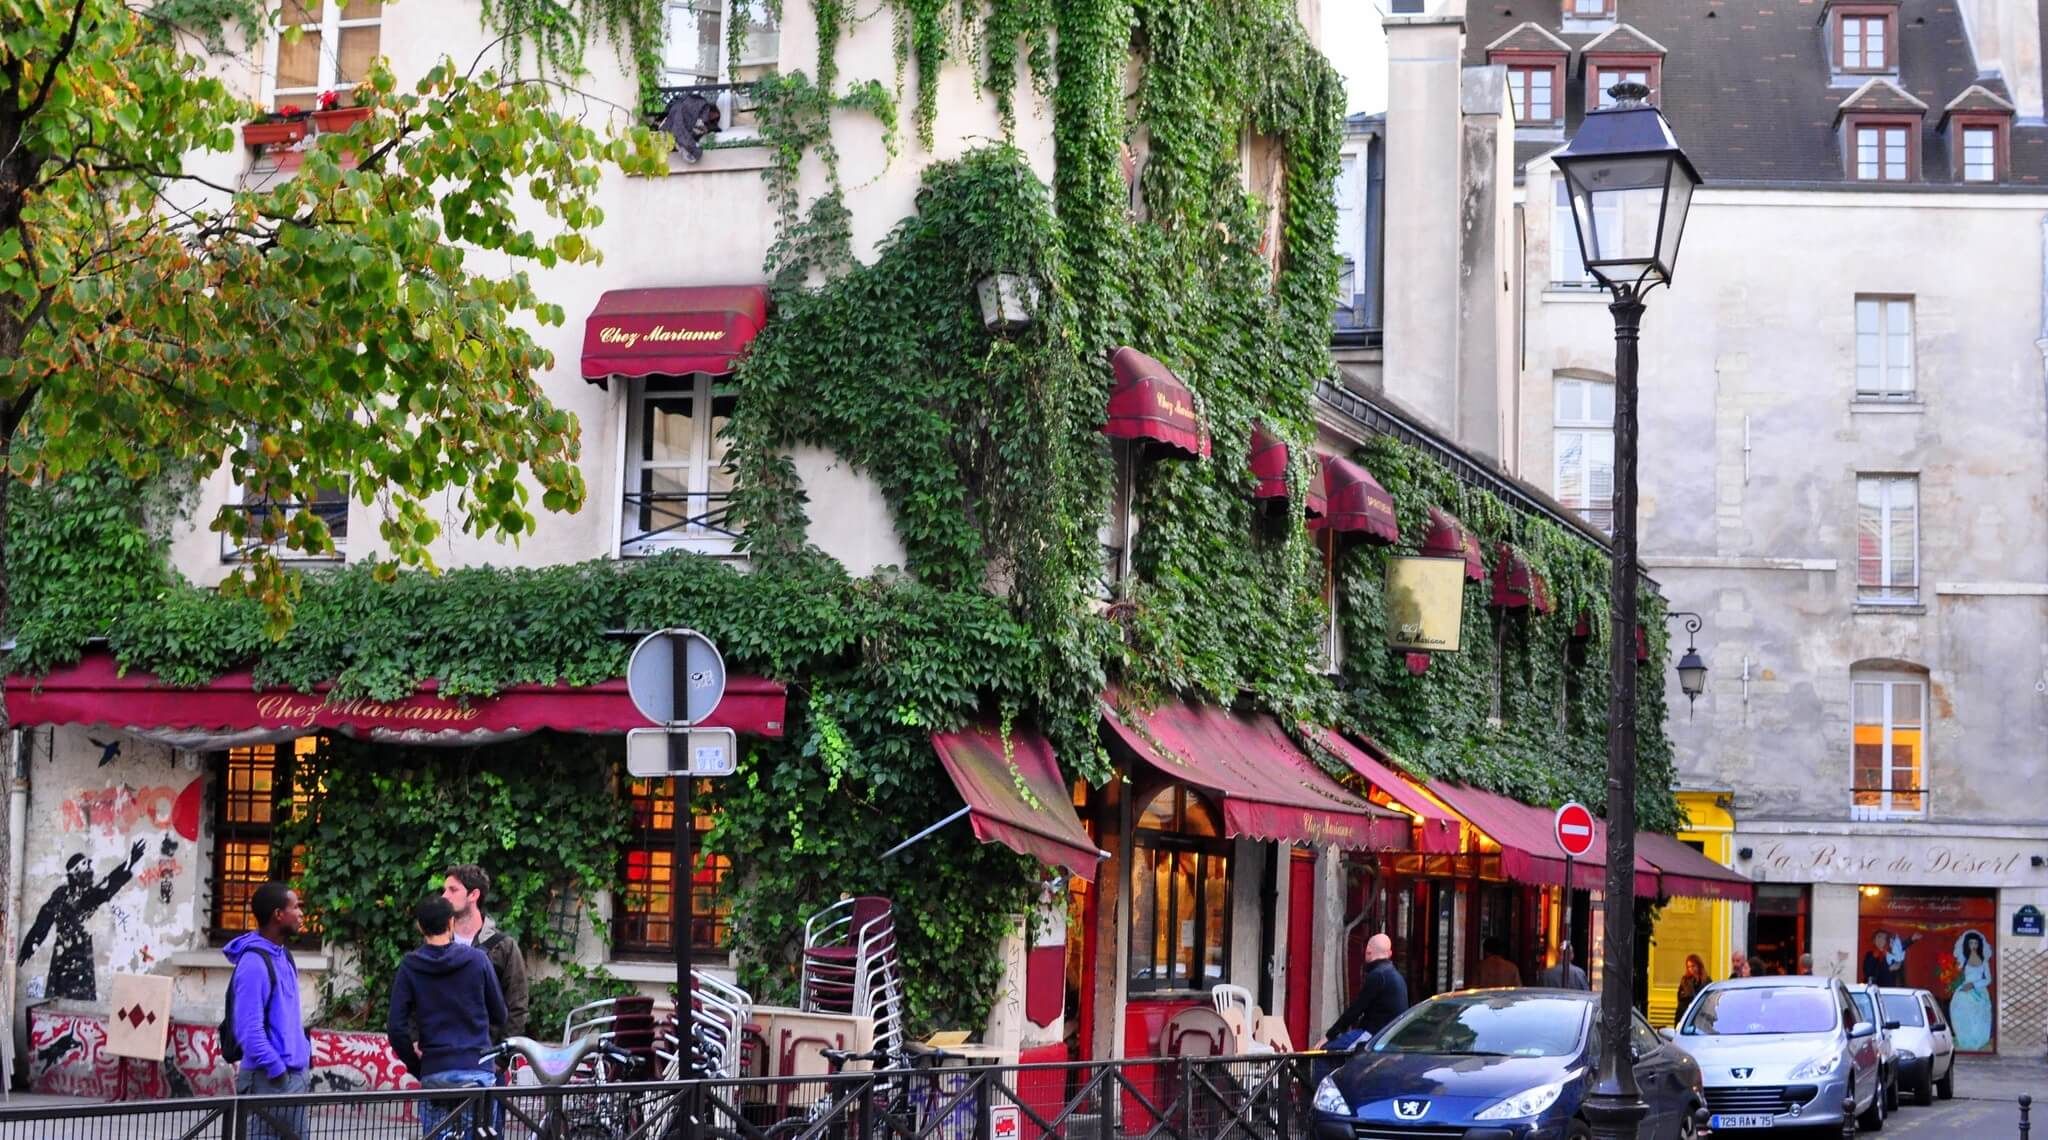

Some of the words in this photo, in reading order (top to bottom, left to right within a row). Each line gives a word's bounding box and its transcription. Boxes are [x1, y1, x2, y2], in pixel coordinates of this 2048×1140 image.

[600, 327, 639, 348] Chez
[643, 325, 726, 342] Marianne
[256, 696, 321, 727] Chez
[329, 696, 480, 721] Marianne
[1887, 856, 1913, 873] du
[1924, 846, 2021, 874] Désert
[1760, 1116, 1771, 1126] 75
